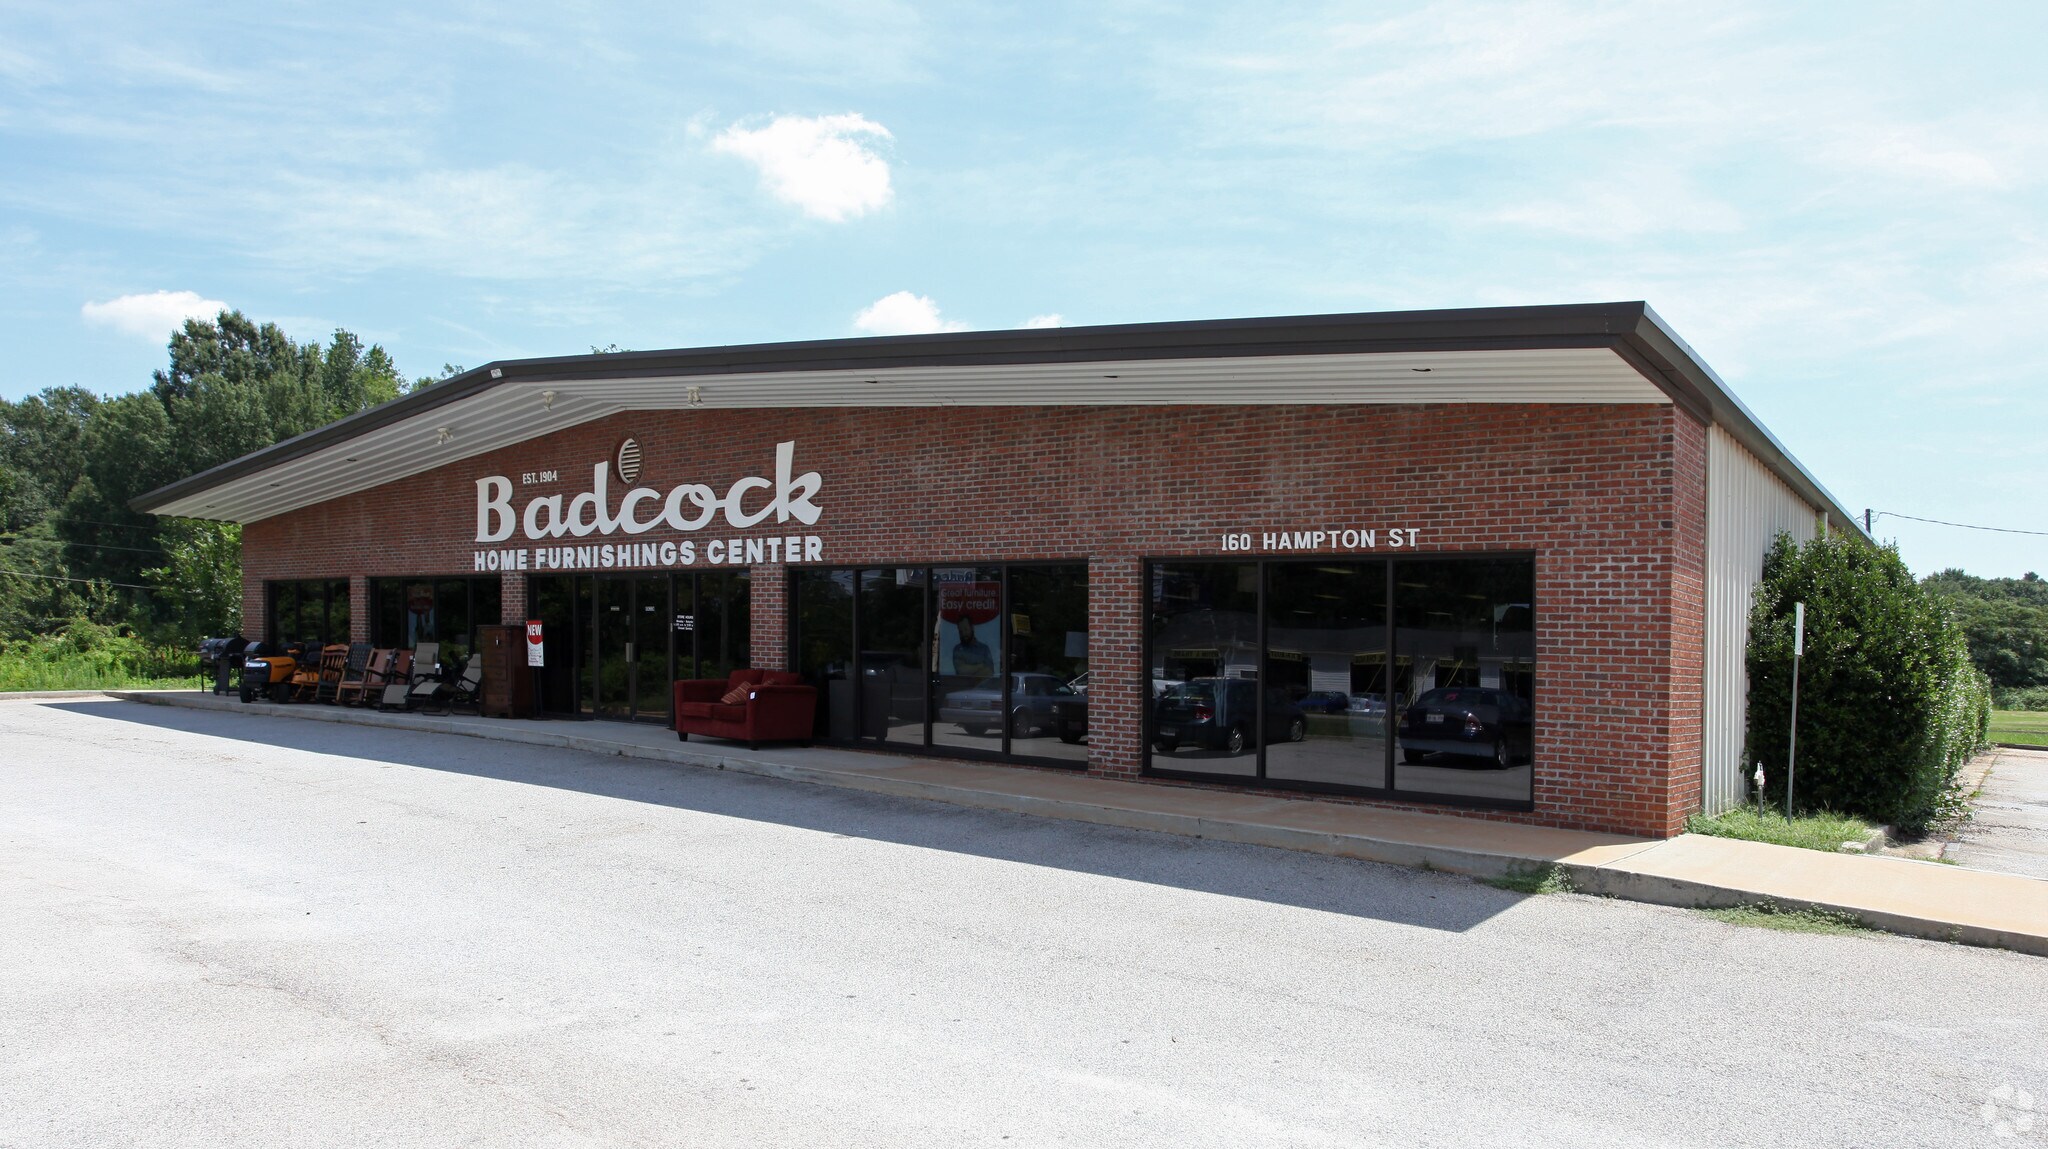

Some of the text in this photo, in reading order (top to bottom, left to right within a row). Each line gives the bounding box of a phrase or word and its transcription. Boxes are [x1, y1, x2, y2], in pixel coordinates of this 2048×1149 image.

[522, 469, 557, 484] EST. 1904
[475, 441, 823, 542] Badcock
[1221, 528, 1420, 551] 160 HAMPTON ST
[474, 536, 823, 572] HOME FURNISHINGS CENTER
[941, 599, 963, 612] Easy
[527, 624, 542, 636] NEW
